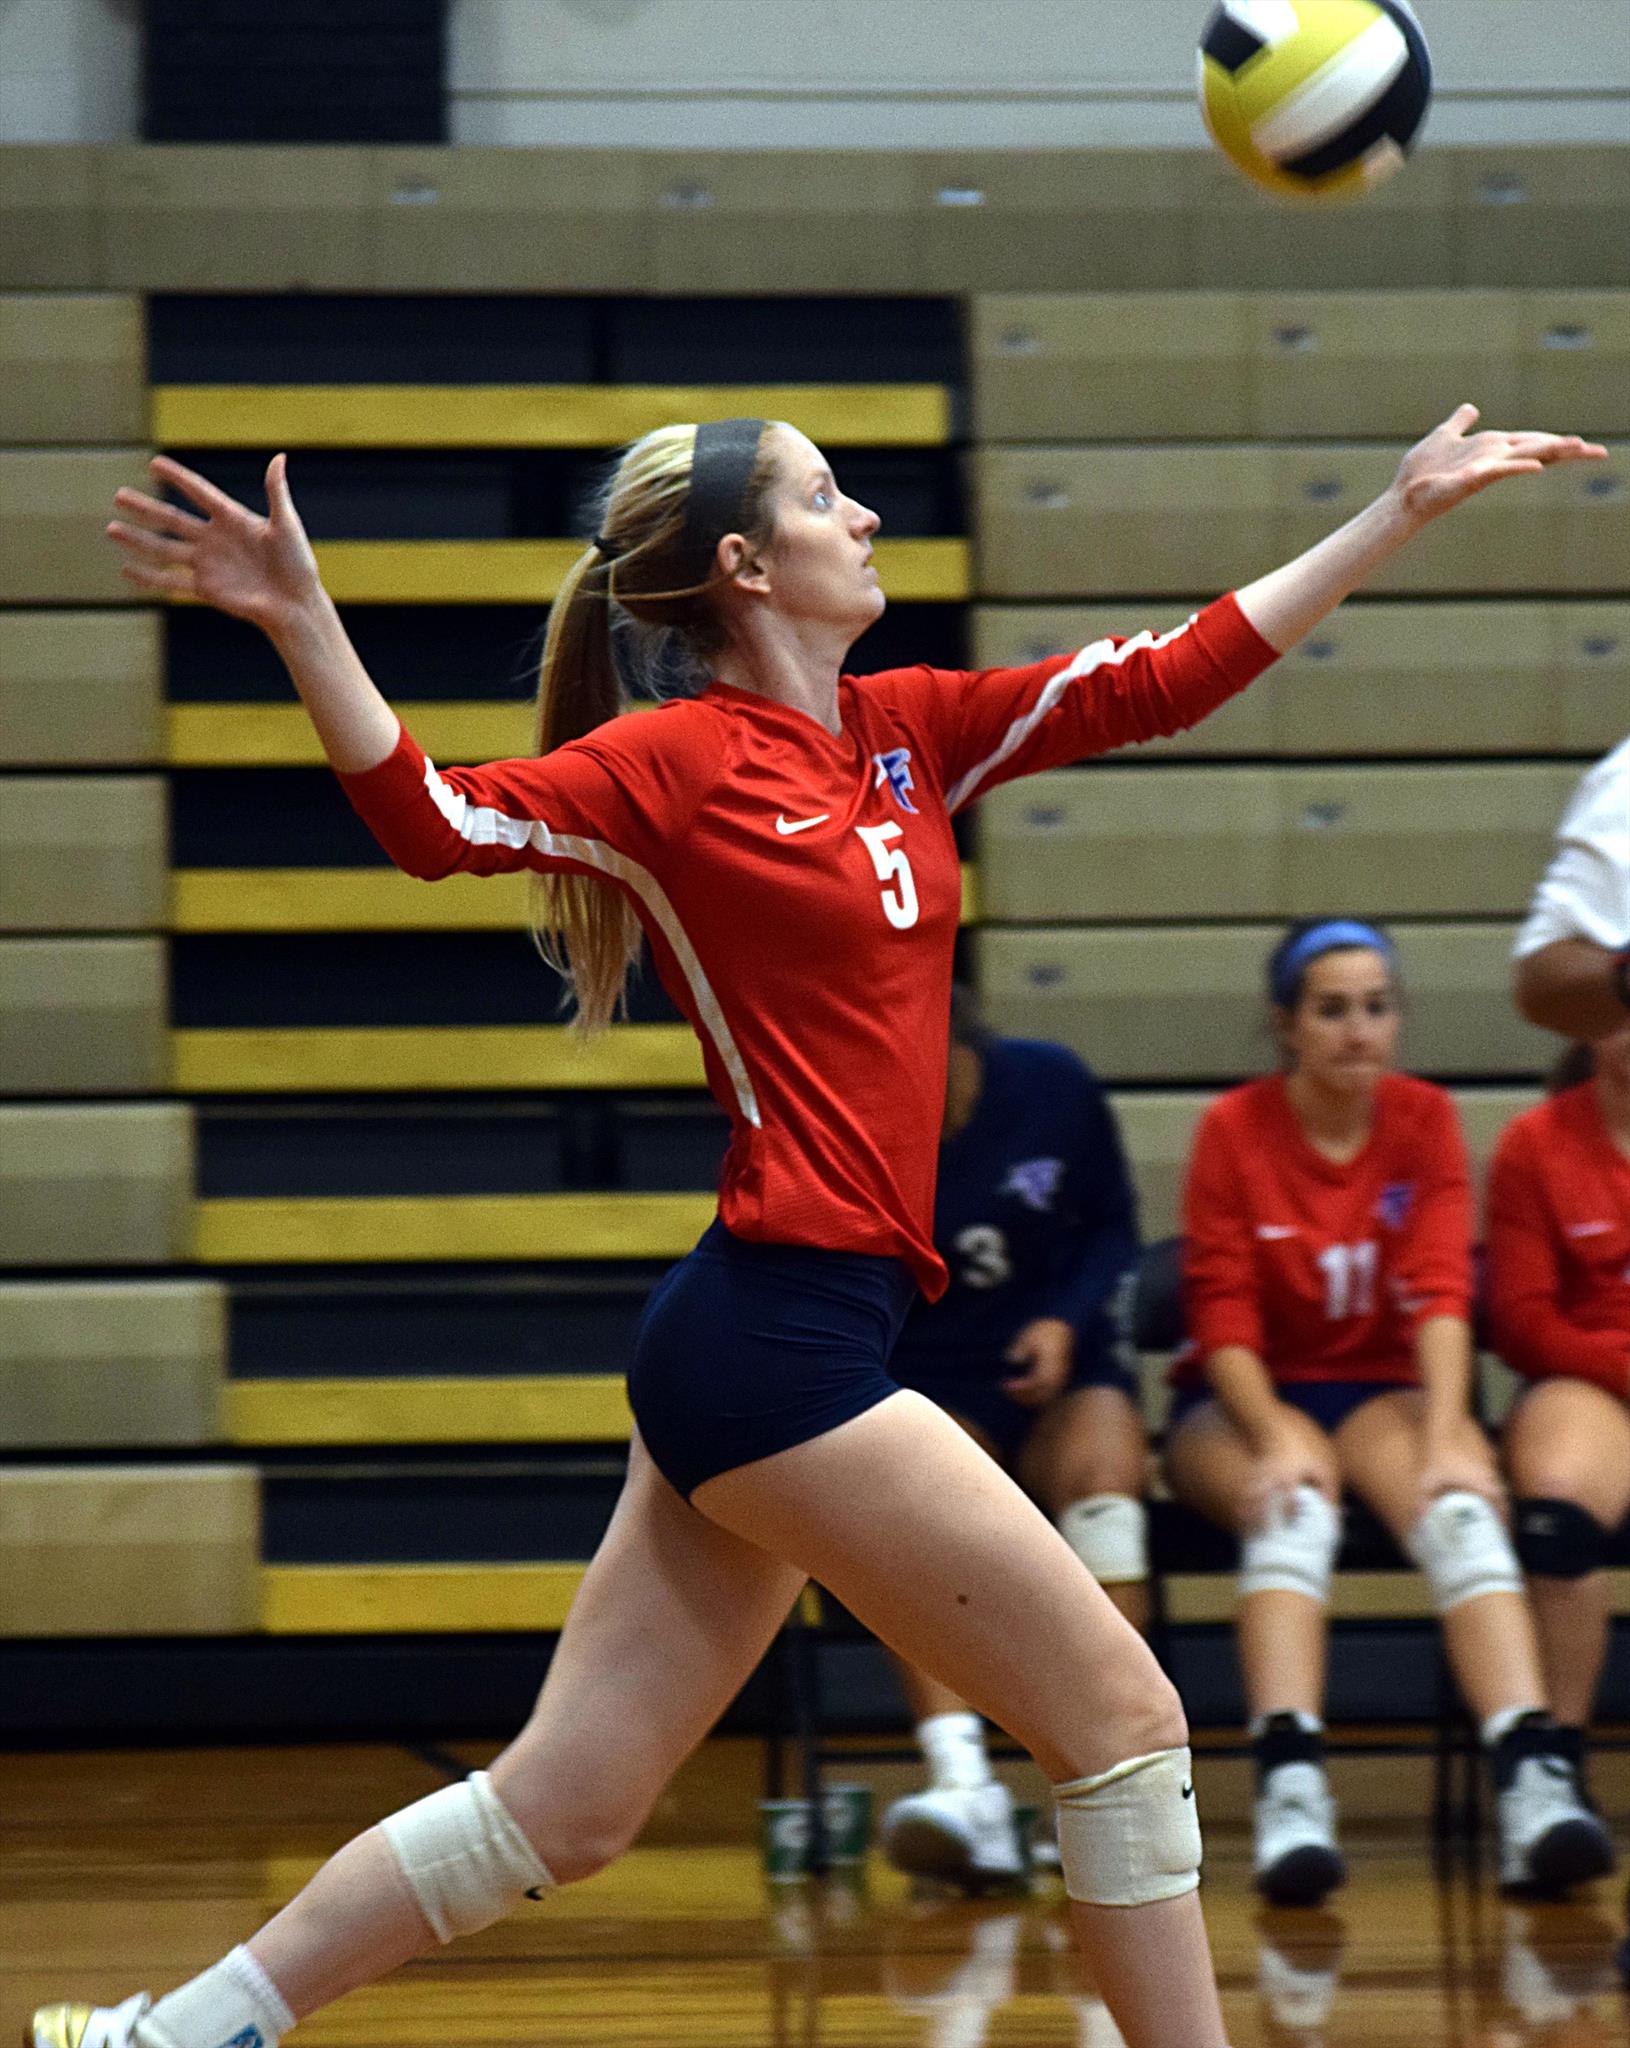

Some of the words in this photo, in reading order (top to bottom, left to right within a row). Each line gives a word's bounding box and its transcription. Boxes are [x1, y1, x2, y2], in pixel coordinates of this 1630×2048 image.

[855, 820, 919, 929] 5
[956, 1226, 1011, 1288] 3
[1318, 1241, 1377, 1318] 11
